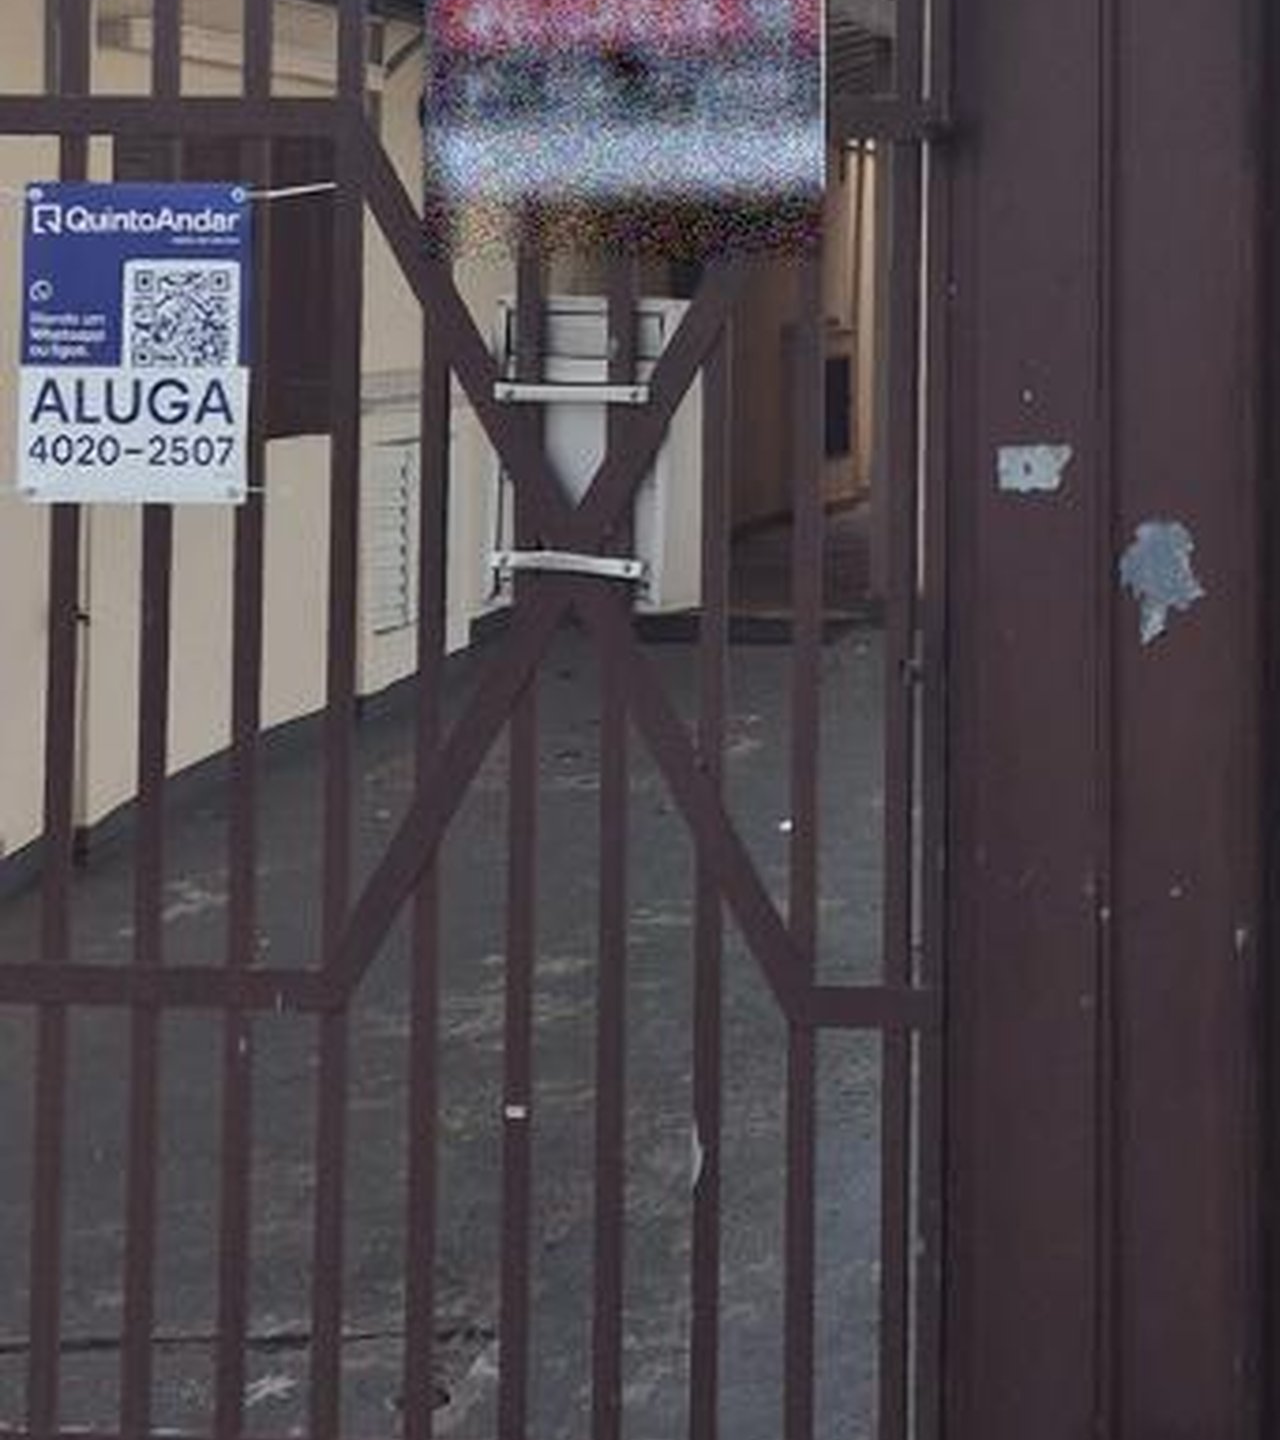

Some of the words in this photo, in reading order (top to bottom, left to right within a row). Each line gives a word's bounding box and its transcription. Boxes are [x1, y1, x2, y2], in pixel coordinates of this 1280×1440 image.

[66, 206, 240, 232] QuintoAndar
[31, 379, 234, 424] ALUGA
[29, 436, 234, 465] 4020-2507
